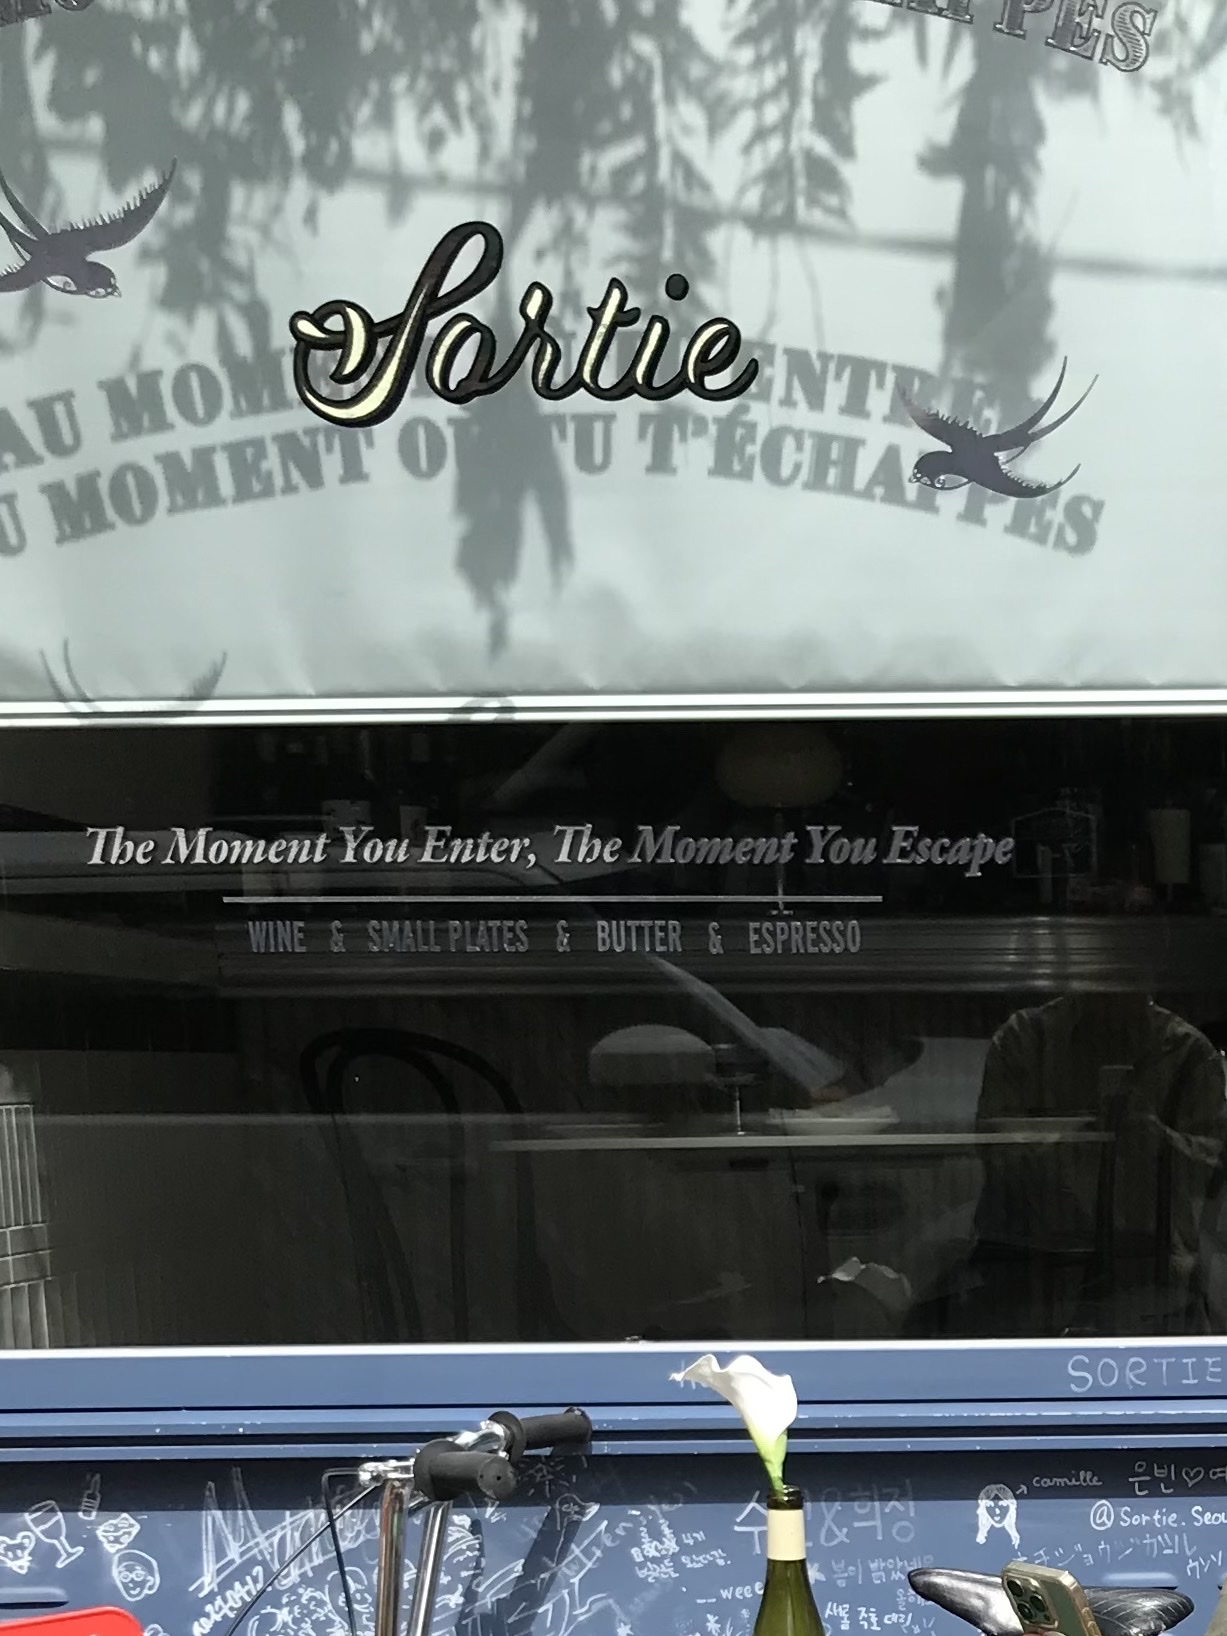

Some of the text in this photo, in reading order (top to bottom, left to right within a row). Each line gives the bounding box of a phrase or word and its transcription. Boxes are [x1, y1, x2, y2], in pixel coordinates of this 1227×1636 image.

[290, 220, 759, 428] Sortie
[40, 426, 375, 546] MOMENT
[86, 823, 1015, 877] The Moment You Enter, The Moment You Escape
[248, 919, 862, 955] WINE & SMALL PLATES & BUTTER & ESPRESSO
[1067, 1354, 1223, 1393] SORTIE
[1032, 1470, 1103, 1487] camille
